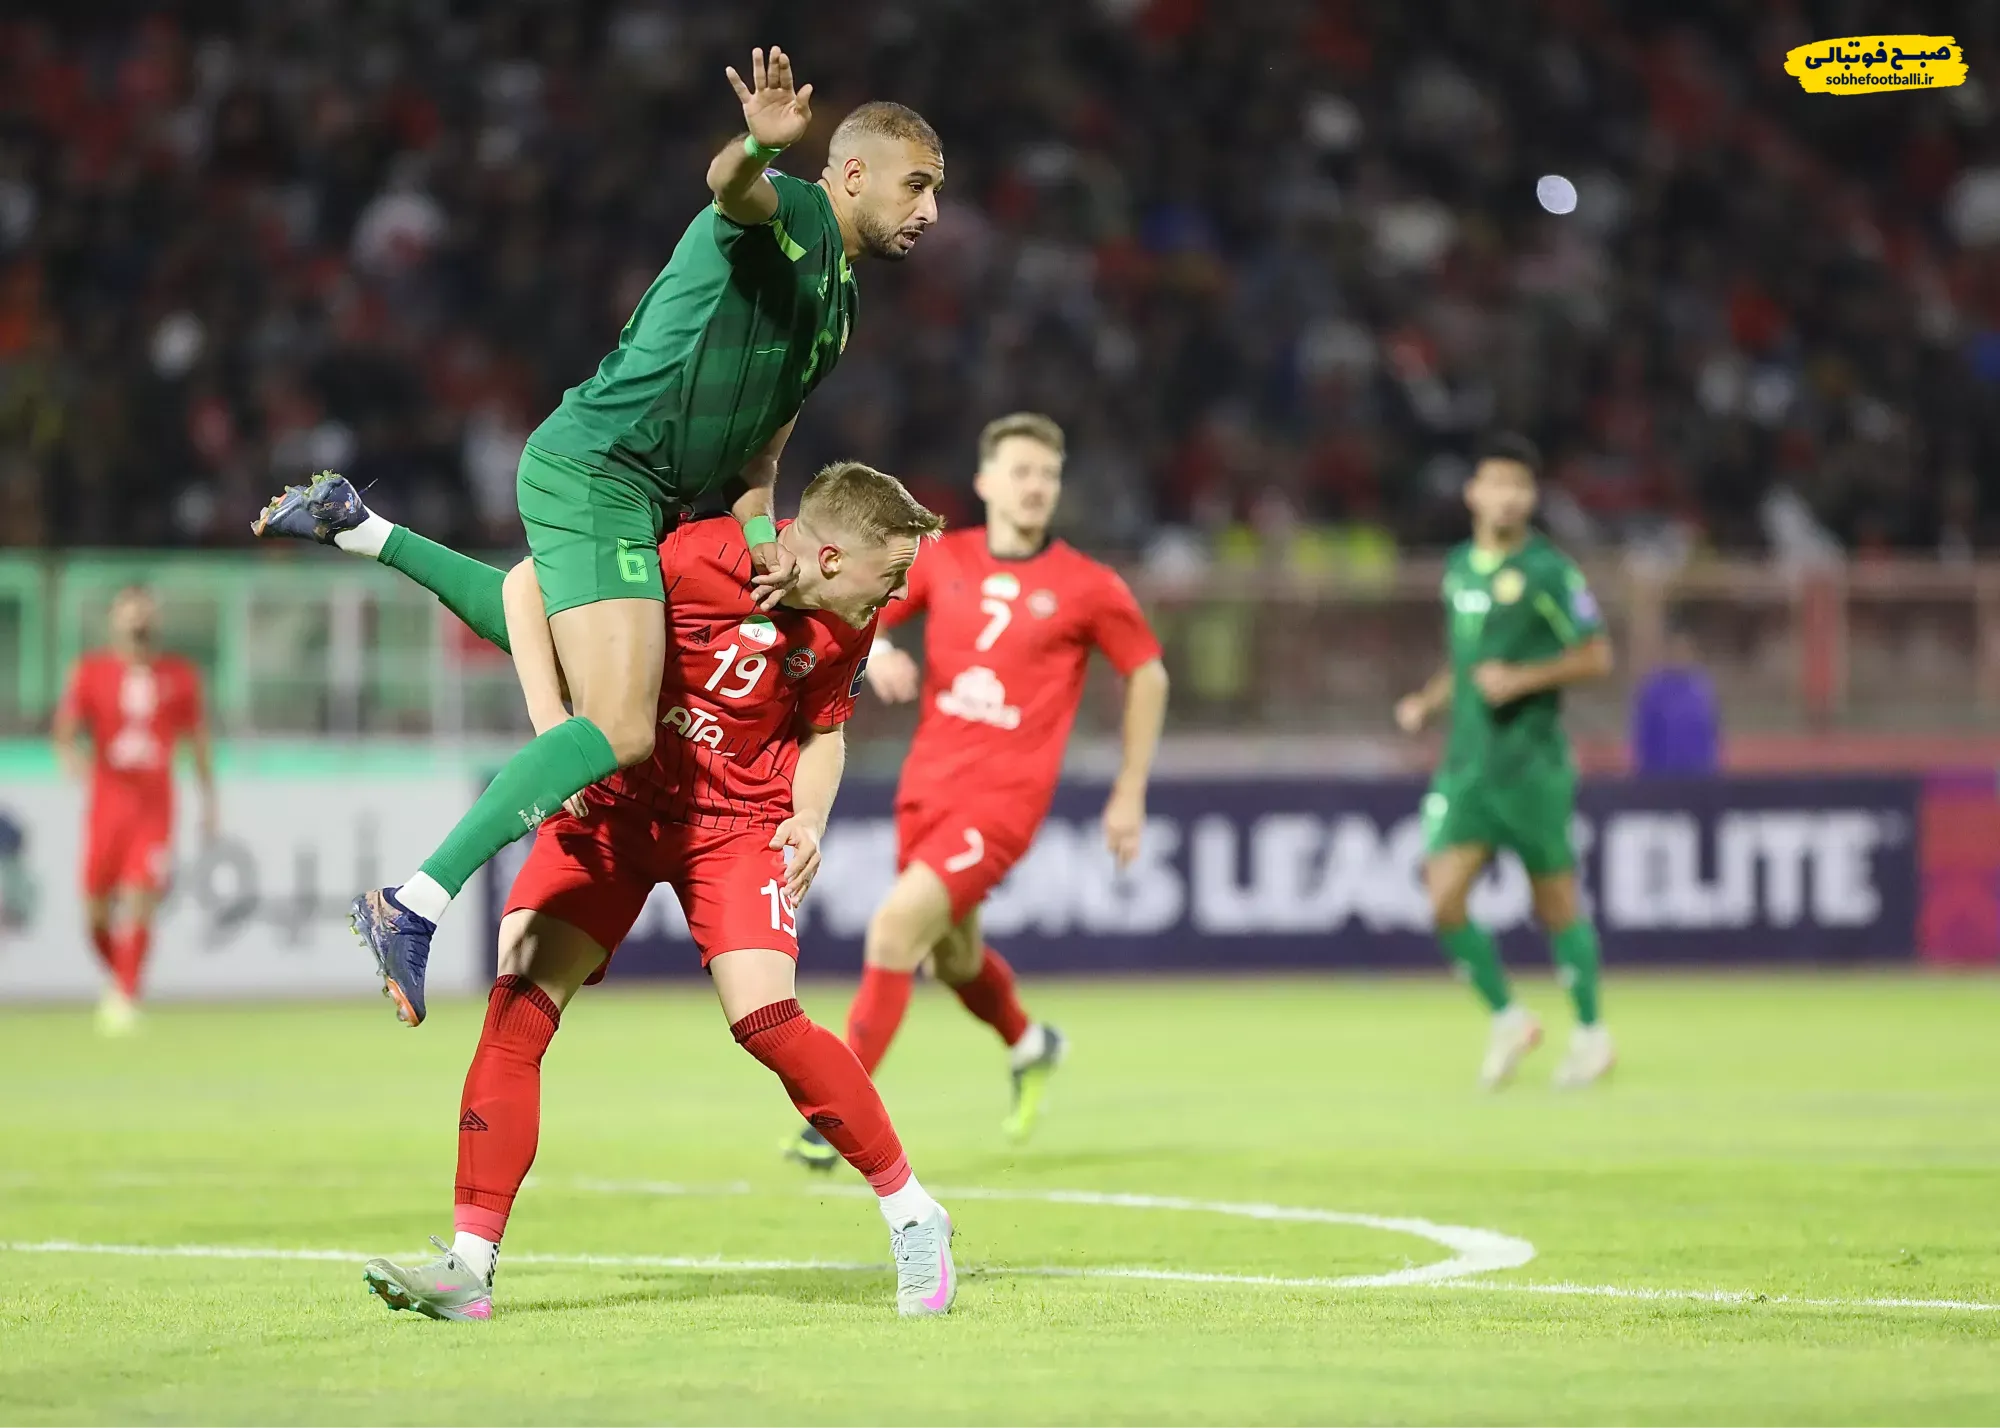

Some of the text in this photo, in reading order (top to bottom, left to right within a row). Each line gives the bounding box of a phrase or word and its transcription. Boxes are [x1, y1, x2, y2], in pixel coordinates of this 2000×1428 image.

[616, 537, 649, 584] 6
[975, 596, 1012, 652] 7
[704, 643, 767, 699] 19
[661, 705, 725, 749] ATA
[944, 826, 985, 873] 7
[1605, 812, 1881, 927] ELITE
[760, 877, 798, 939] 19
